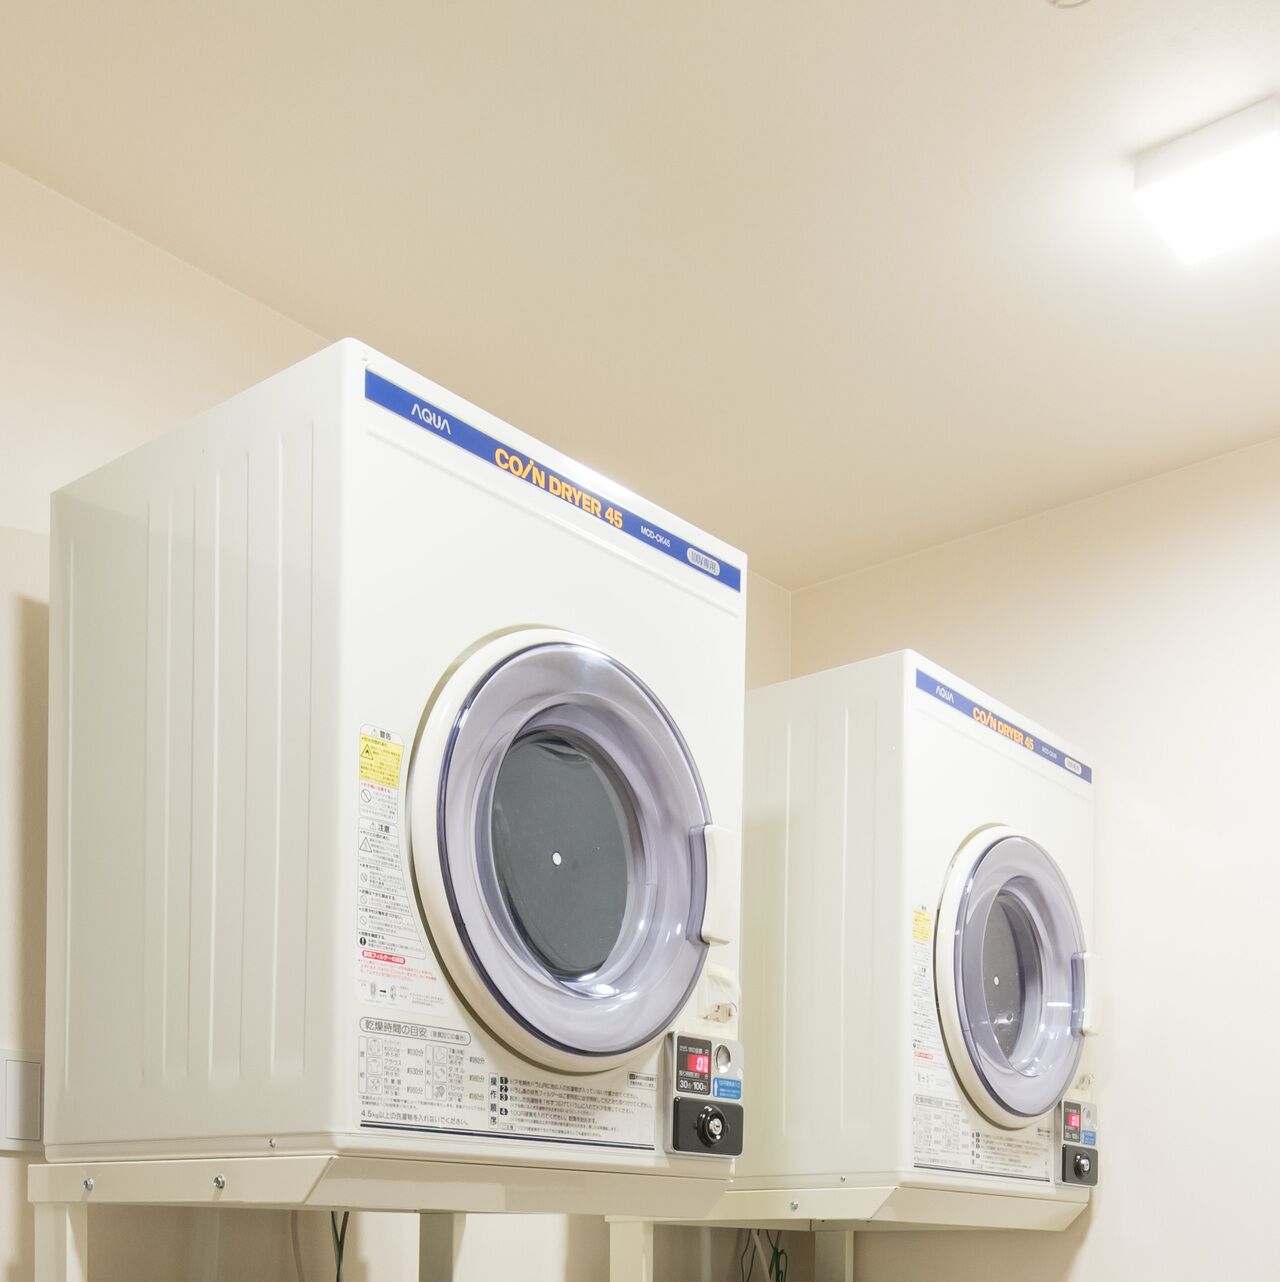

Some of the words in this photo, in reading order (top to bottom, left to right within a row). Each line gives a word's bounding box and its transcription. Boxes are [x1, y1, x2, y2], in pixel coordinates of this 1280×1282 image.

[411, 403, 451, 435] AQUA
[548, 475, 602, 518] DRYER
[604, 507, 623, 529] 45
[935, 686, 955, 704] AQUA
[998, 721, 1024, 745] DRYER
[1025, 735, 1034, 751] 45
[378, 824, 390, 833] 注意
[365, 1020, 427, 1038] 乾燥時間の目安
